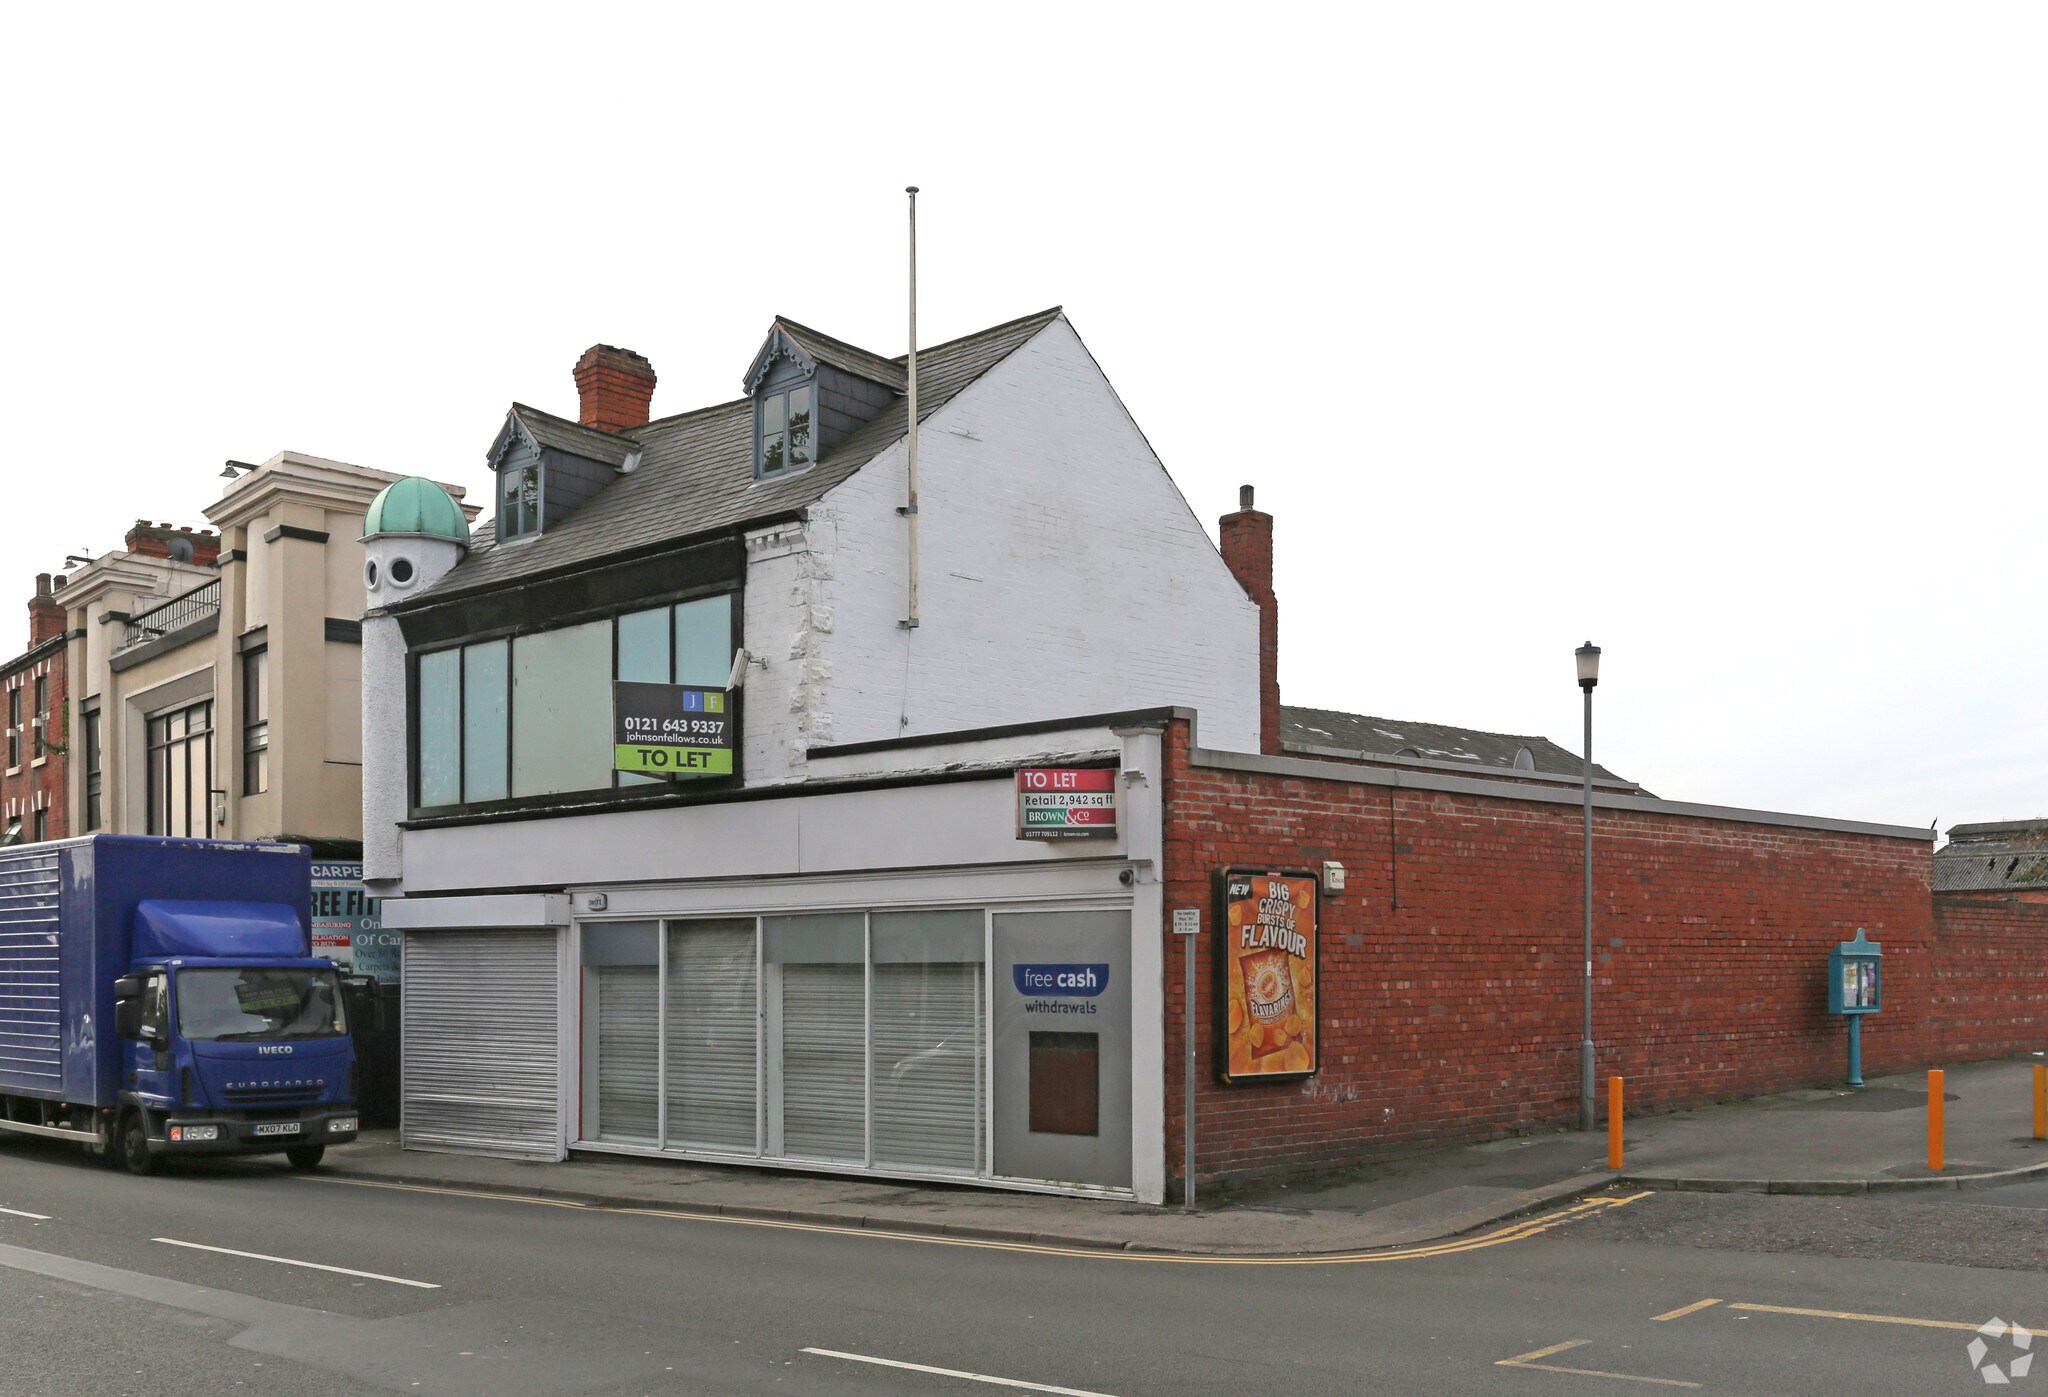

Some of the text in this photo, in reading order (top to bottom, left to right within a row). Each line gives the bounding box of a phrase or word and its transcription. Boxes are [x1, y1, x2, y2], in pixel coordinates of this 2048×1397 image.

[690, 694, 716, 709] J F
[624, 717, 724, 734] 0121 643 9337
[626, 732, 724, 744] johnsonfellows.co.uk
[638, 750, 712, 768] TO LET
[1025, 772, 1076, 788] TO LET
[1026, 794, 1113, 806] Retail 2,942 sq ft
[311, 866, 363, 878] CARPE
[1230, 882, 1290, 900] NEW BIG
[1259, 898, 1296, 918] CRISPY
[360, 918, 382, 930] On
[1258, 914, 1296, 930] BURSTS OF
[356, 934, 376, 946] Of
[1242, 925, 1307, 958] FLAVOUR
[1025, 968, 1096, 988] free cash
[1025, 1000, 1096, 1014] withdrawals
[258, 1046, 292, 1054] IVECO
[226, 1079, 324, 1088] EUROCARGO
